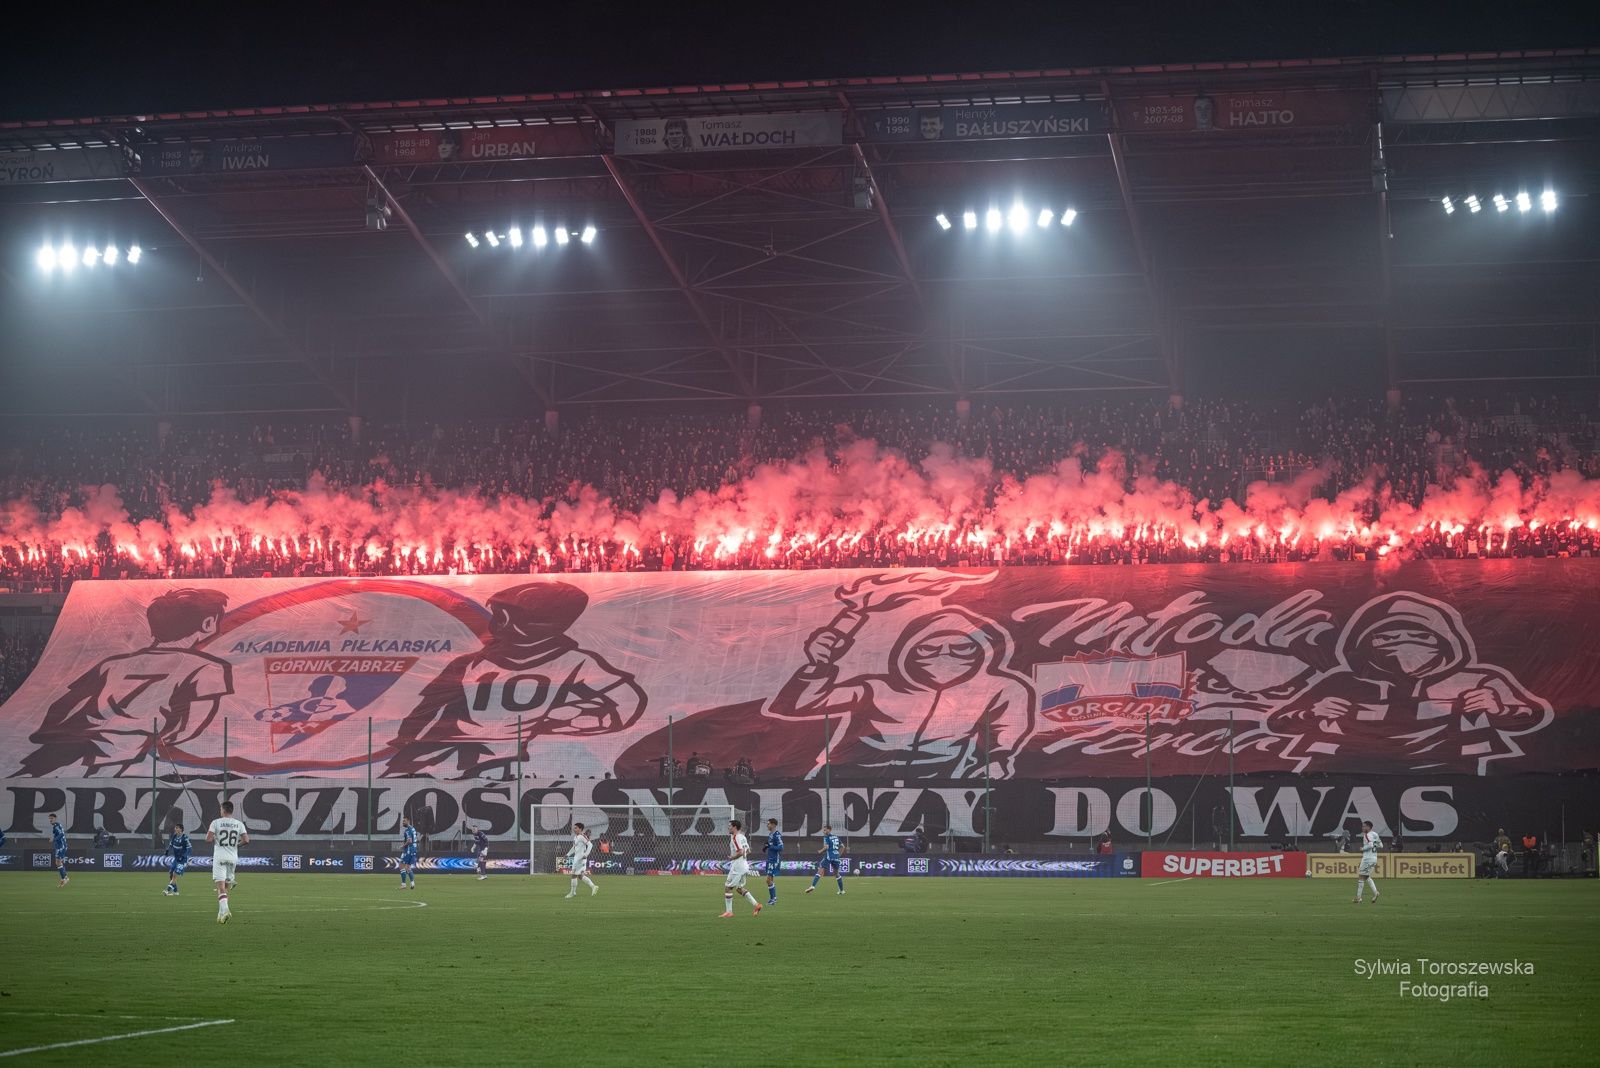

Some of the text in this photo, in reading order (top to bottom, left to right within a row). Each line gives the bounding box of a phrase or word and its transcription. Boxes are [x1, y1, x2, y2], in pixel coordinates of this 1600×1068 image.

[1229, 98, 1273, 107] Tomasz
[886, 116, 910, 125] 1990
[955, 108, 996, 120] Henryk
[1229, 109, 1294, 126] HAJTO
[701, 120, 742, 130] Tomasz
[955, 115, 1089, 137] BAŁUSZYŃSKI
[471, 131, 490, 141] Jan
[700, 130, 796, 147] WAŁDOCH
[223, 143, 262, 154] Andrzej
[471, 142, 536, 158] URBAN
[222, 154, 269, 170] IWAN
[229, 639, 452, 654] AKADEMIA PIŁKARSKA
[336, 659, 406, 673] ZABRZE
[123, 673, 170, 709] 7
[472, 671, 552, 712] 10
[1045, 701, 1172, 719] TORCIDA
[4, 779, 1459, 837] PRZYSZŁOŚĆ NALEŻY DO WAS
[219, 829, 238, 847] 26
[63, 856, 96, 865] ForSec
[309, 857, 344, 866] ForSec
[859, 861, 896, 870] ForSec
[1162, 854, 1284, 877] SUPERBET
[1315, 861, 1380, 875] PsiBut
[1400, 861, 1465, 875] PsiBufet
